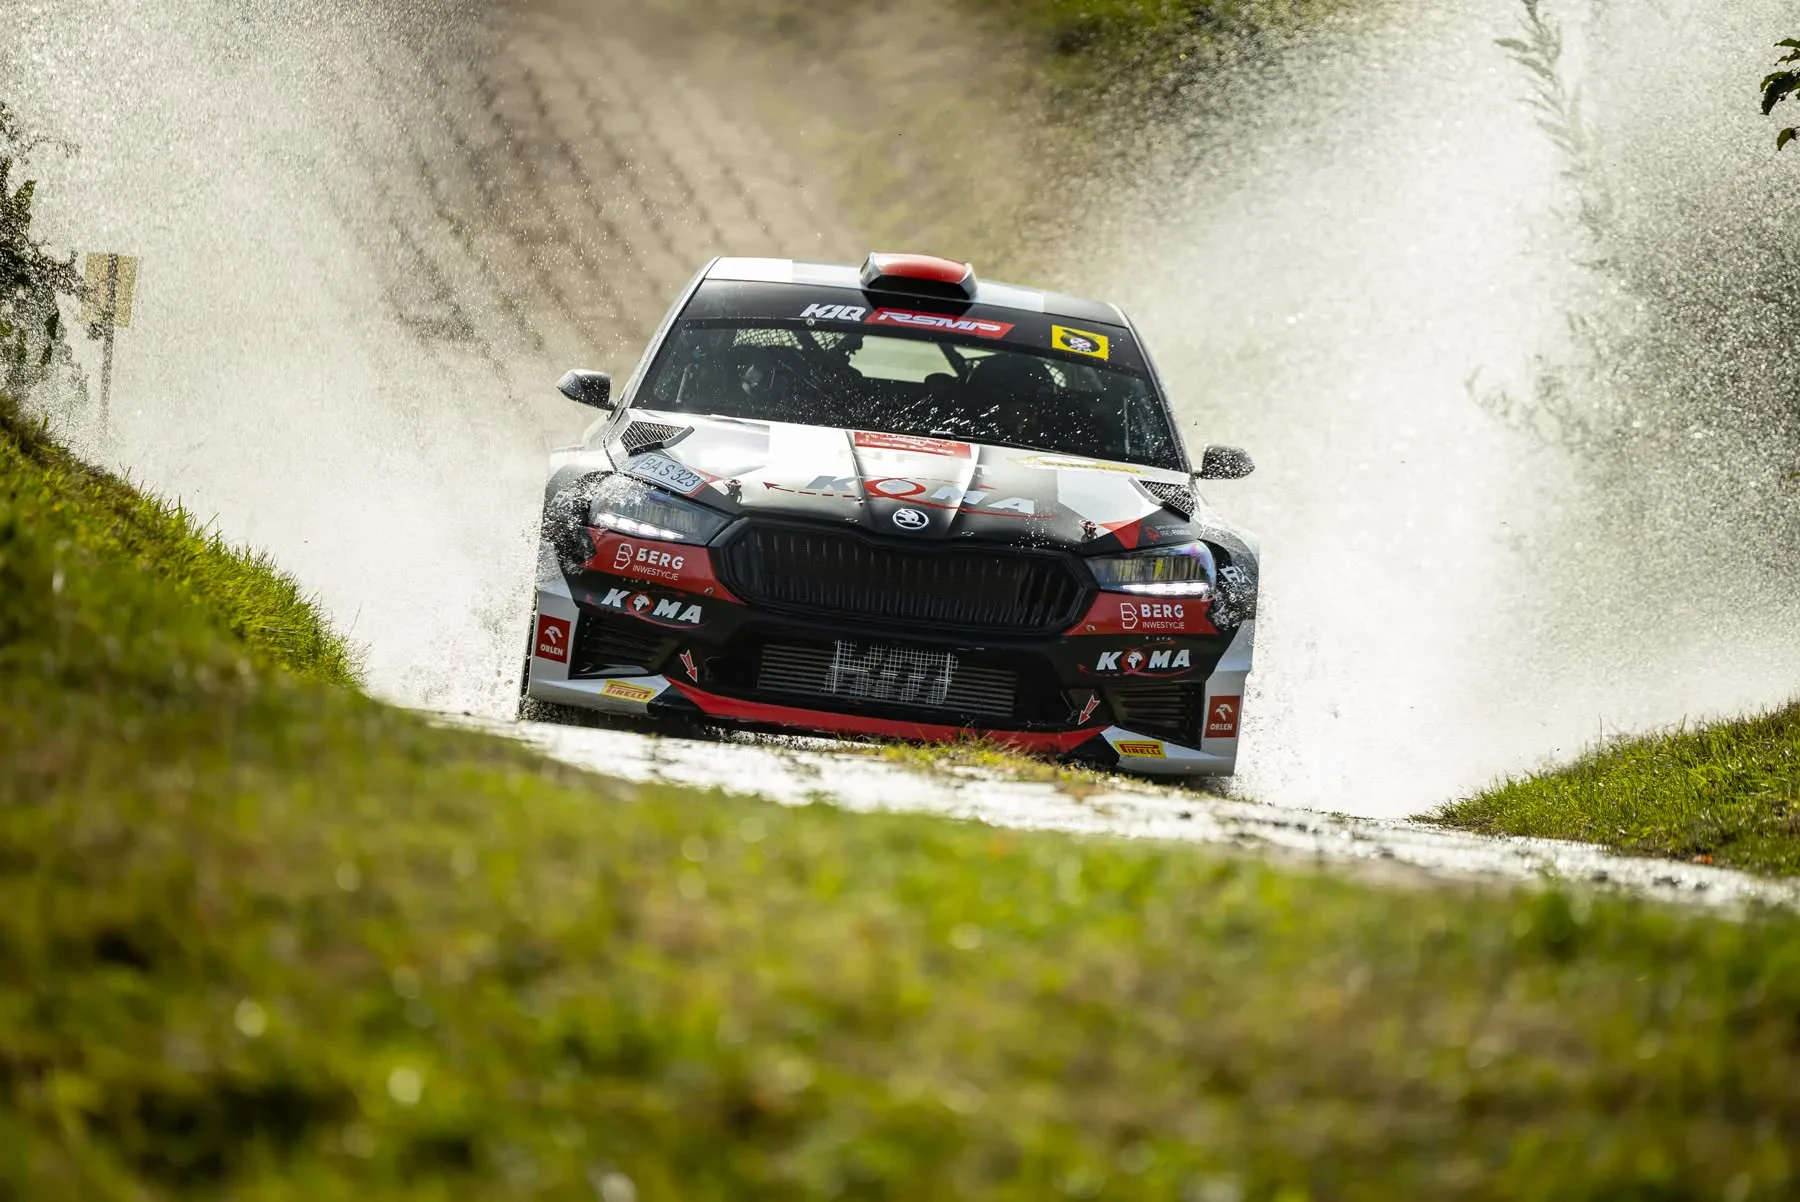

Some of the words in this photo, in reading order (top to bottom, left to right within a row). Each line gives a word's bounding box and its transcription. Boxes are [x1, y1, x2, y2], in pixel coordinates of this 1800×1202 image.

[877, 311, 1001, 332] RSMP
[671, 469, 701, 488] 323
[636, 548, 685, 570] BERG
[632, 564, 679, 581] INWESTYCJE
[600, 588, 702, 625] KOMA
[1140, 603, 1184, 619] BERG
[1141, 621, 1185, 630] INWESTYCJE
[540, 643, 564, 656] ORLEN
[1096, 649, 1190, 671] KOMA
[605, 684, 652, 700] PIRELLI
[1209, 723, 1233, 731] ORLEN
[1119, 743, 1162, 756] PIRELLI
